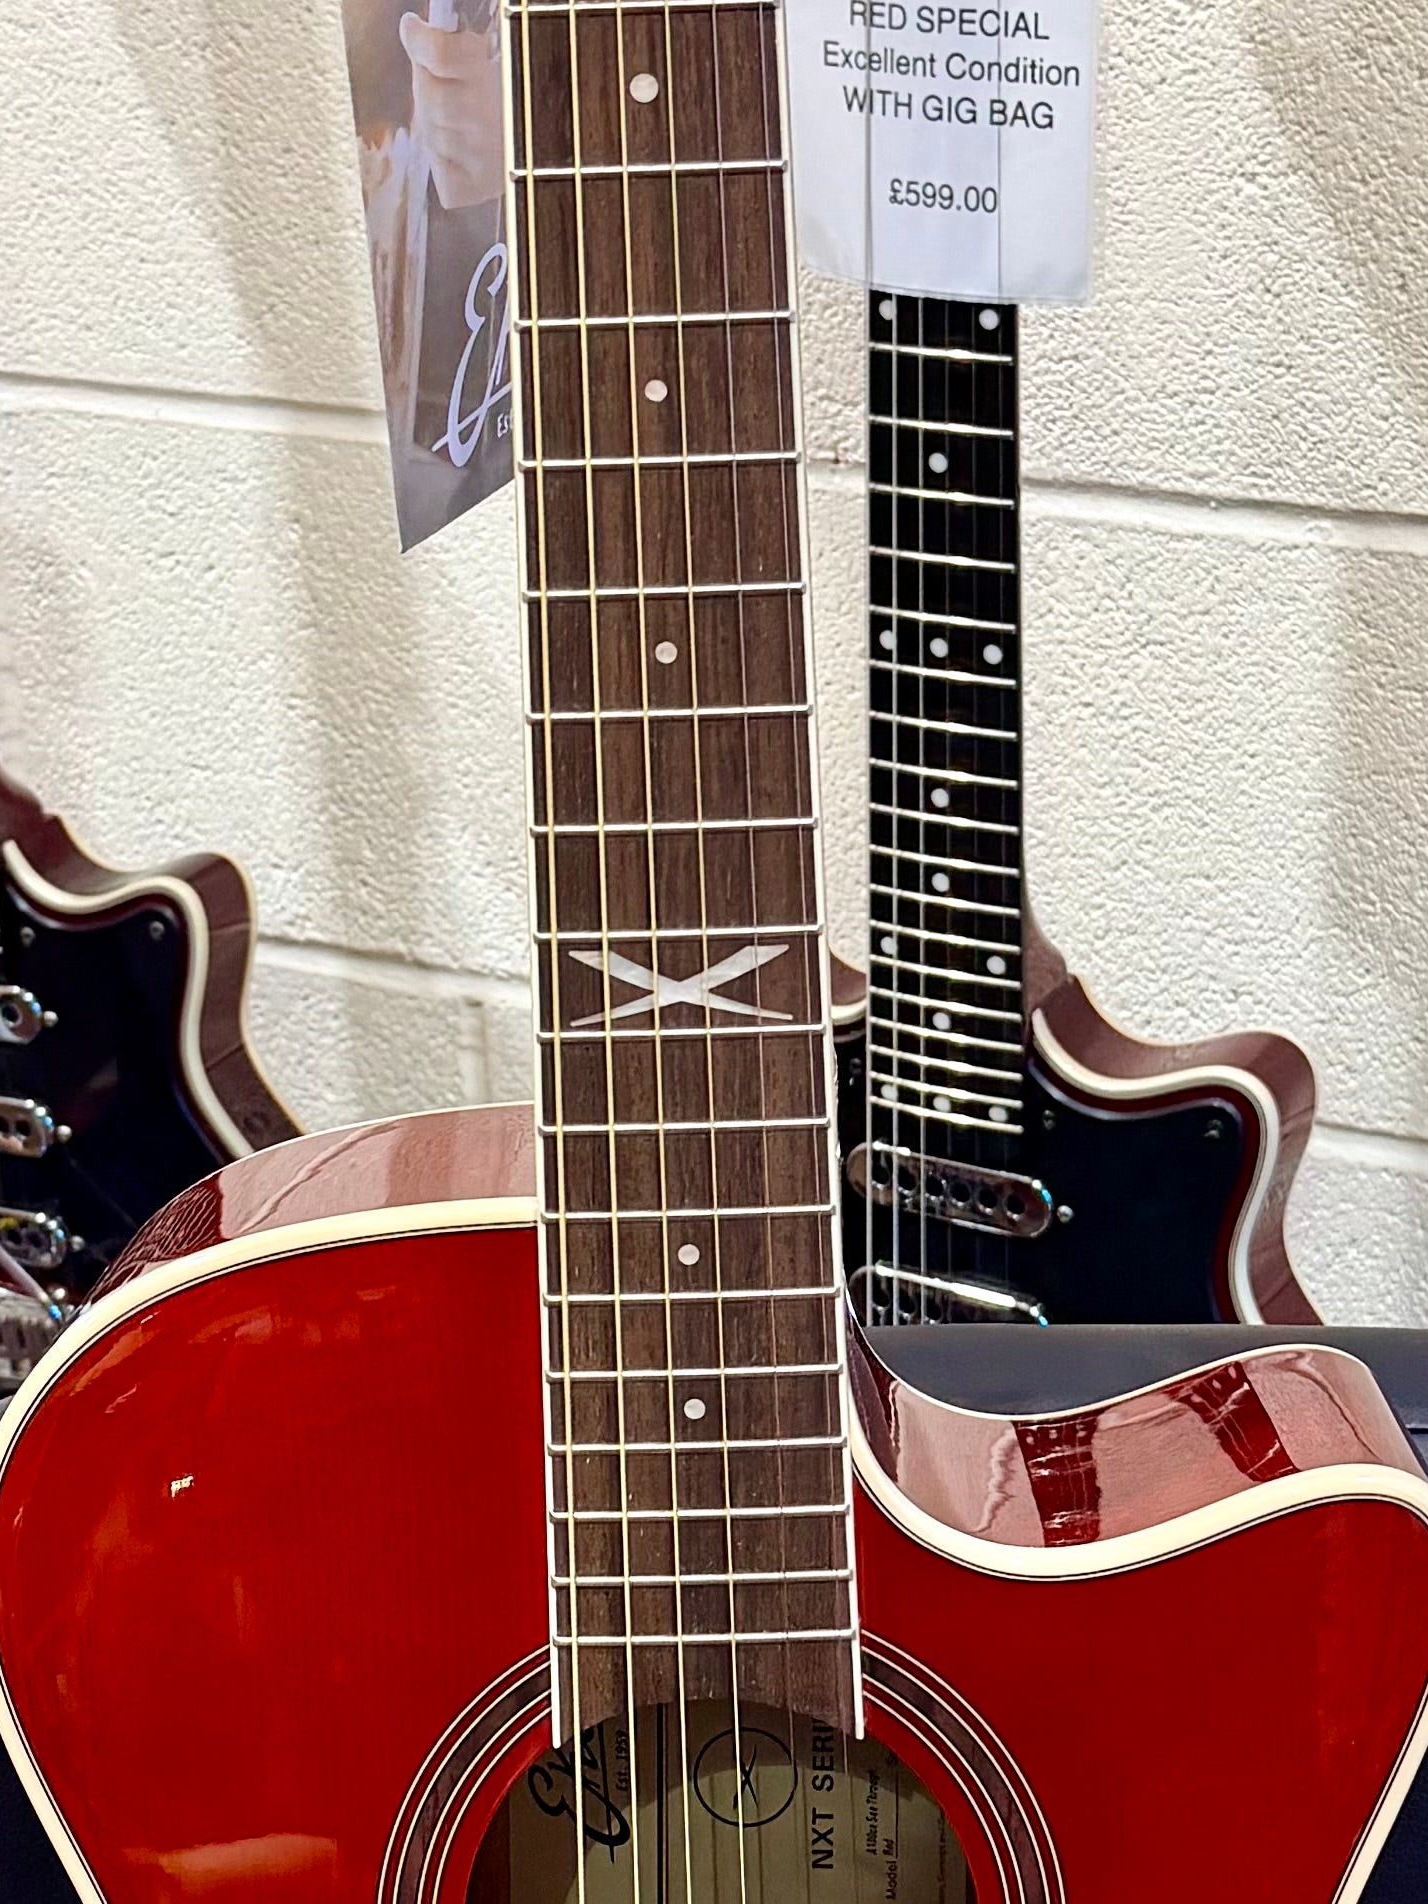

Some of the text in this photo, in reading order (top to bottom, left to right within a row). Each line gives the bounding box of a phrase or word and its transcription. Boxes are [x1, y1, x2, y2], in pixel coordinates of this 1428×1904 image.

[849, 0, 1051, 42] RED SPECIAL
[823, 40, 1081, 88] Excellent Condition
[843, 85, 1055, 130] WITH GIG BAG
[888, 178, 999, 214] £599.00
[811, 1718, 835, 1869] NXT SERI
[884, 1860, 898, 1901] Model
